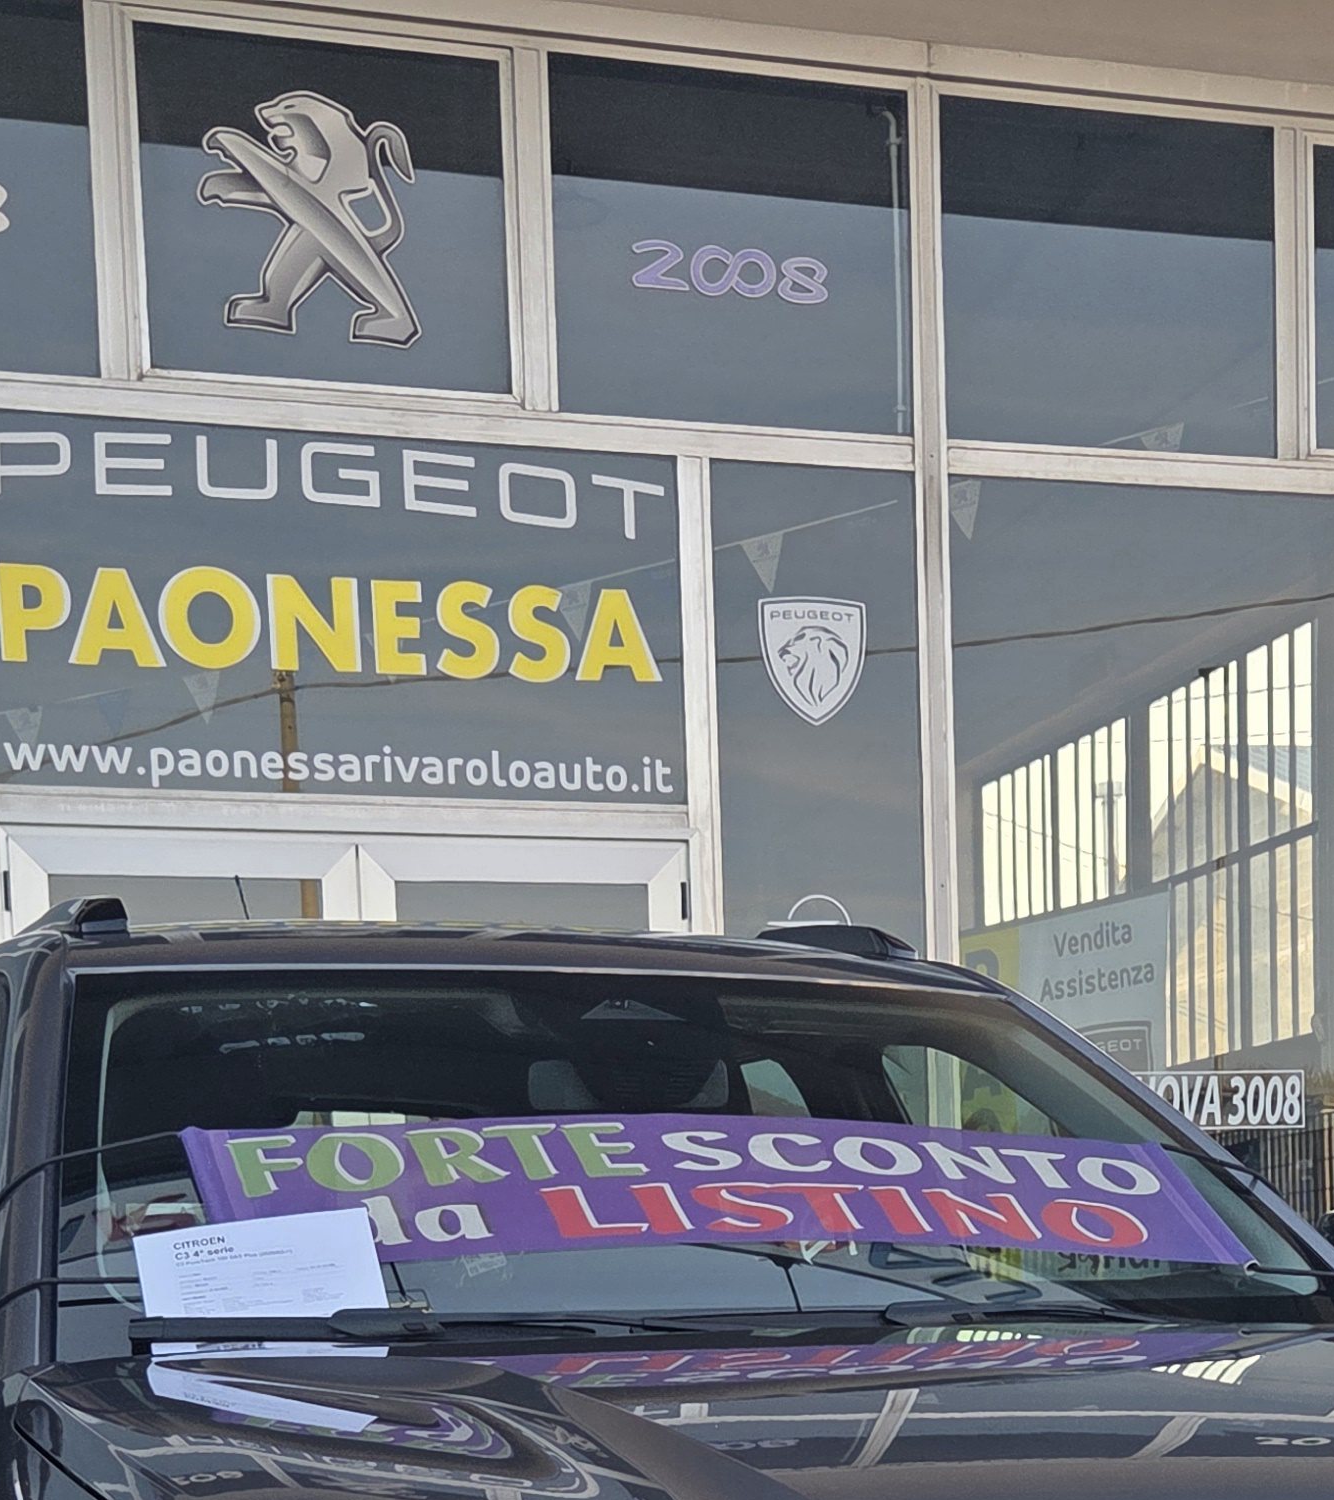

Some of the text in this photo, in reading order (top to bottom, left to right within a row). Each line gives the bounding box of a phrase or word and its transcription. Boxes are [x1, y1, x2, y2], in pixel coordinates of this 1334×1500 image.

[630, 239, 829, 305] 2008
[768, 608, 856, 626] PEUGEOT
[3, 740, 674, 795] www.paonessarivaroloauto.it
[1053, 920, 1134, 958] Vendita
[1040, 961, 1155, 1003] Assistenza
[1228, 1075, 1301, 1126] 3008
[224, 1122, 1162, 1198] FORTE SCONTO
[539, 1182, 1150, 1250] LISTINO
